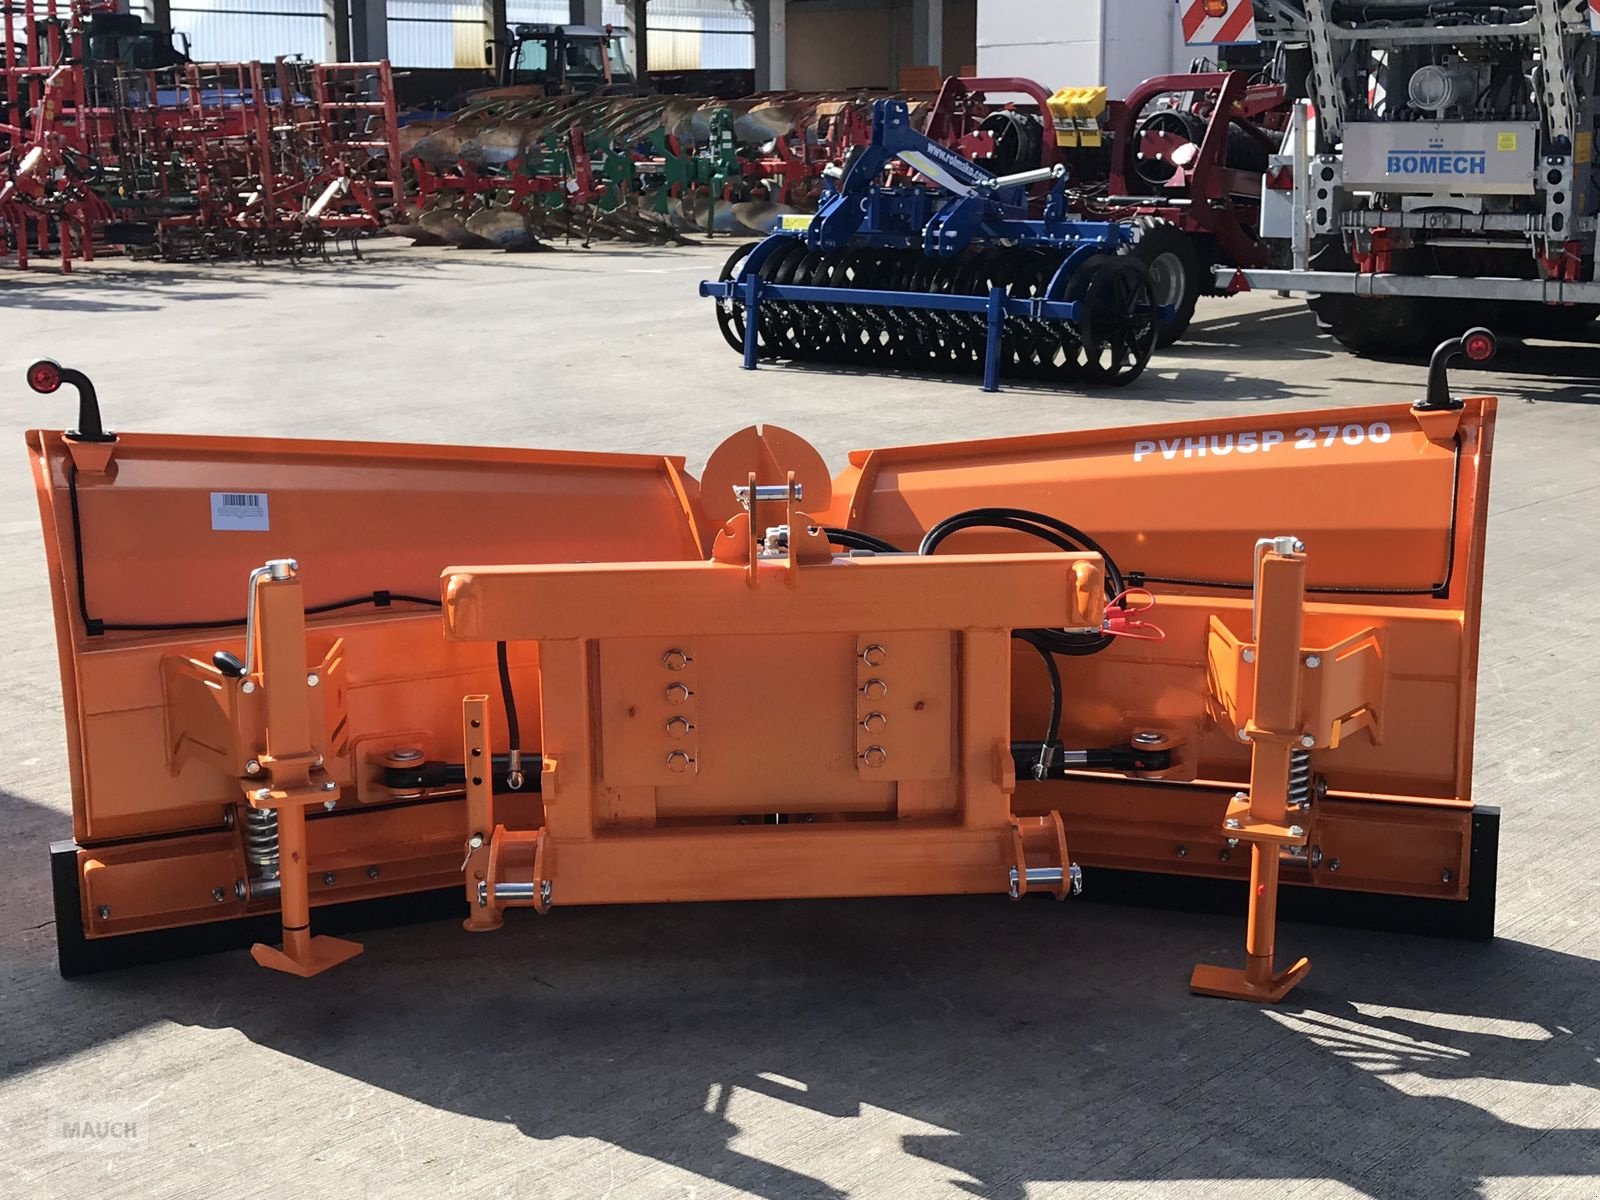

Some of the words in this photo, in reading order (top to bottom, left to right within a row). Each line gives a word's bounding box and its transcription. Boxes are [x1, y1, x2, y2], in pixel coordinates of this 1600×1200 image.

[1387, 156, 1486, 174] BOMECH
[1133, 431, 1285, 463] PVHU5P
[1294, 421, 1392, 450] 2700
